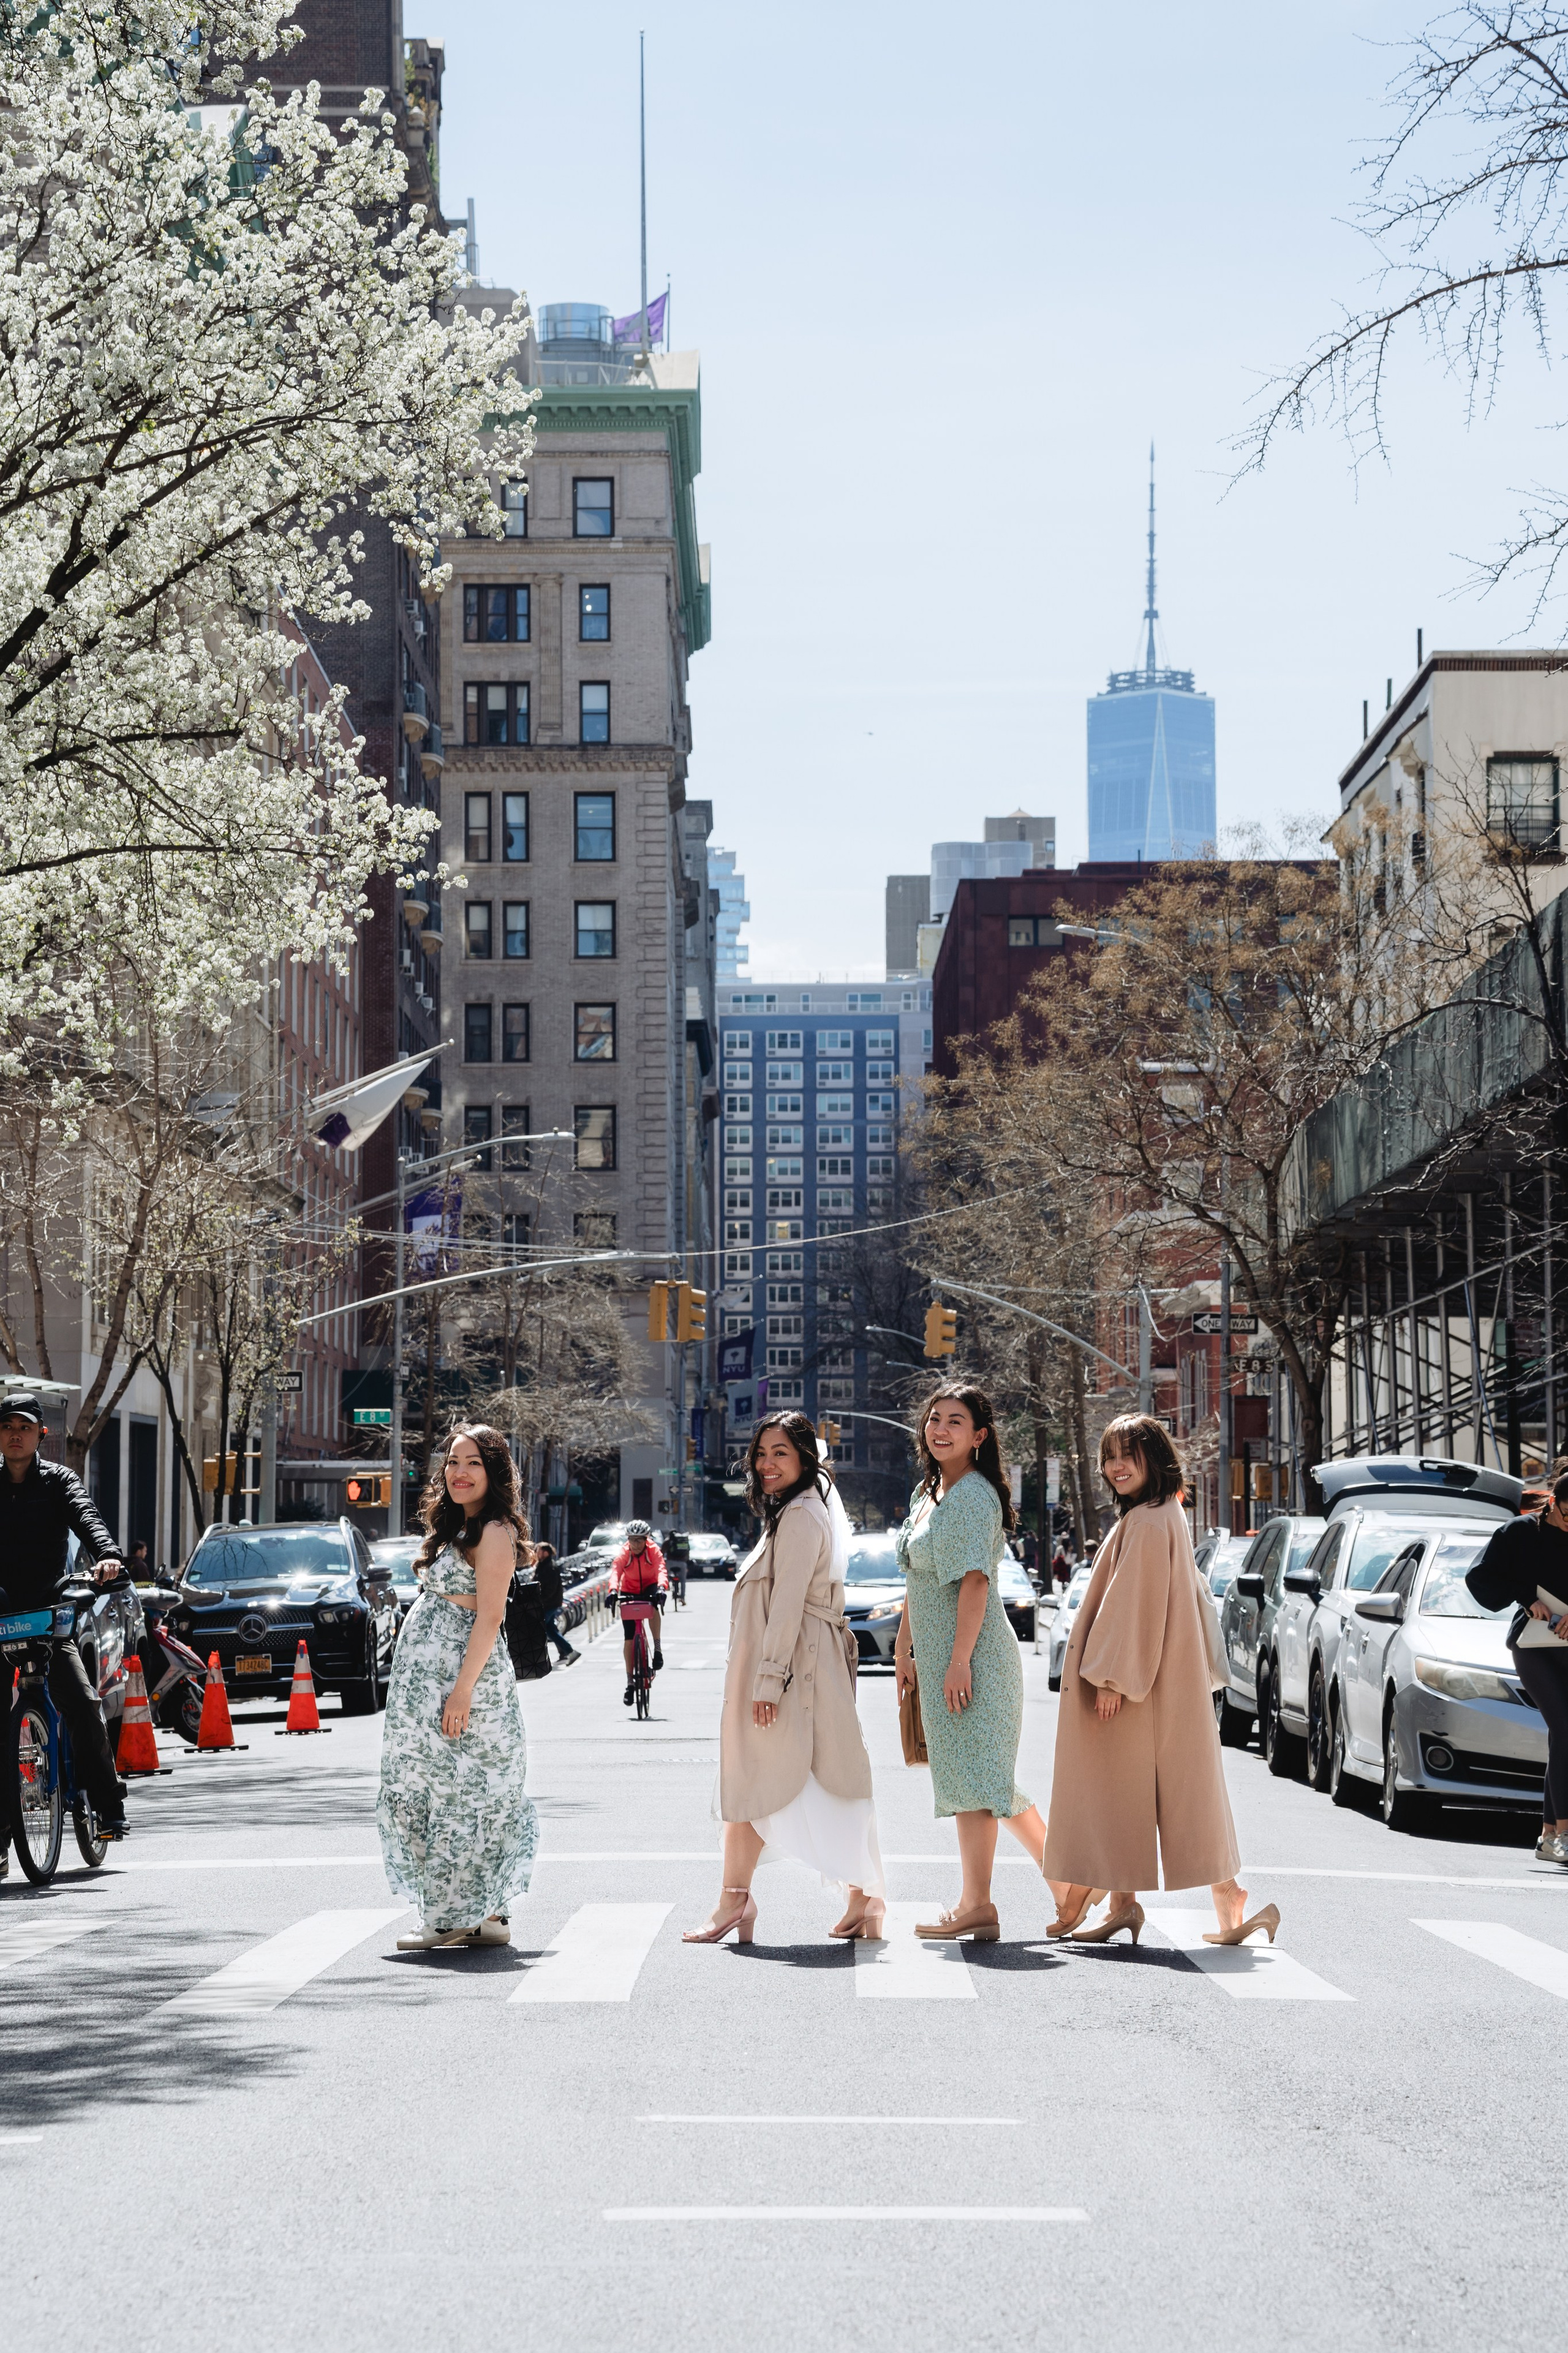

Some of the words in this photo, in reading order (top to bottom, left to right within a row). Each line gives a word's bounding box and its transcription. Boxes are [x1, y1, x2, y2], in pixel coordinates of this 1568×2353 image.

[360, 1412, 365, 1422] E
[369, 1412, 376, 1422] 8
[734, 1414, 752, 1424] NYU
[7, 1622, 32, 1634] bike
